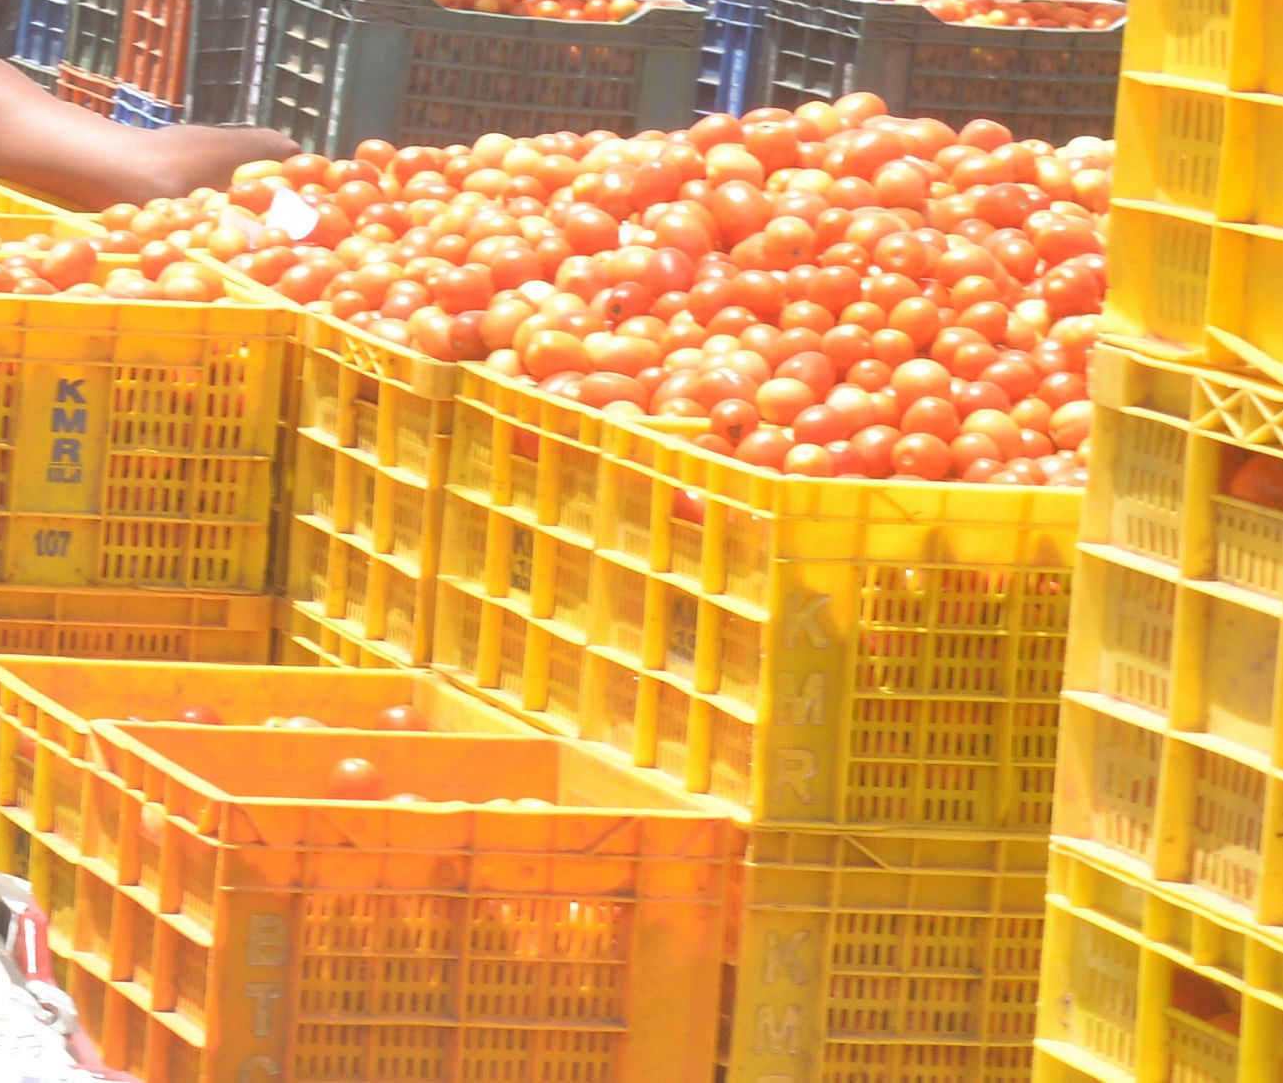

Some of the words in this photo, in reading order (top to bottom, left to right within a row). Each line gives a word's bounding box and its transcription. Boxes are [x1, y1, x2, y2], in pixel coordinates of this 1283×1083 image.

[49, 378, 88, 463] KMR
[34, 529, 72, 558] 107
[771, 592, 831, 806] KMR
[753, 930, 813, 1083] KM
